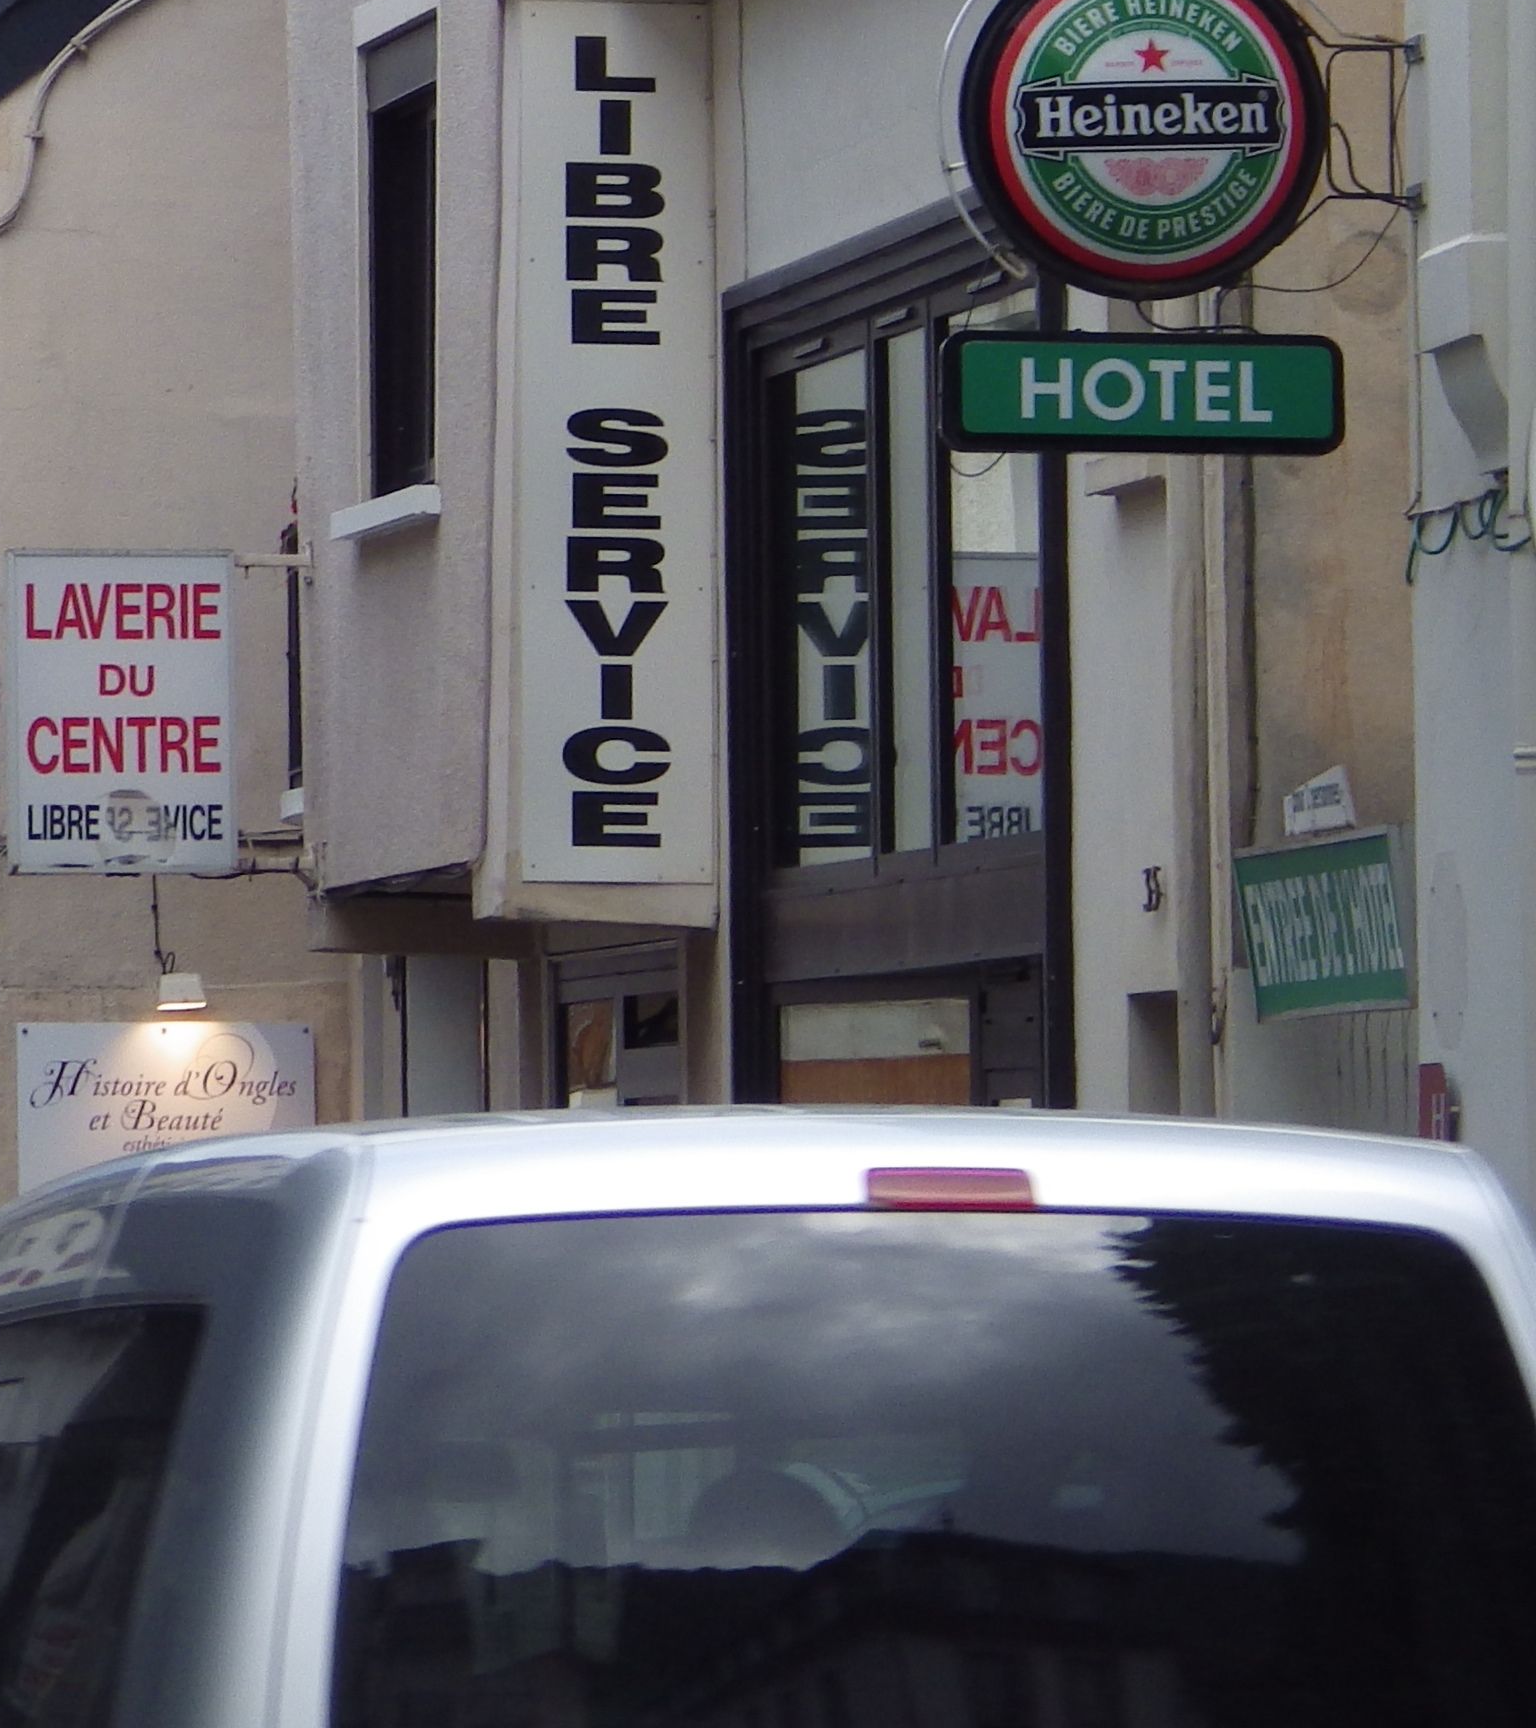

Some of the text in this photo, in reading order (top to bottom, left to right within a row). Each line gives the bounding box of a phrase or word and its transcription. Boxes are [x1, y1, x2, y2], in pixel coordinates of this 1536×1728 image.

[1052, 1, 1120, 57] BIERE
[1034, 91, 1269, 139] Heineken
[1053, 168, 1258, 241] BIERE DE PRESTIGE
[1021, 357, 1273, 423] HOTEL
[562, 36, 672, 848] LIBRE SERVICE
[25, 583, 222, 640] LAVERIE
[98, 664, 155, 697] DU
[26, 716, 222, 774] CENTRE
[27, 804, 100, 841] LIBRE
[29, 1041, 297, 1109] Histoire d'Ongles
[88, 1099, 224, 1134] et Beauté
